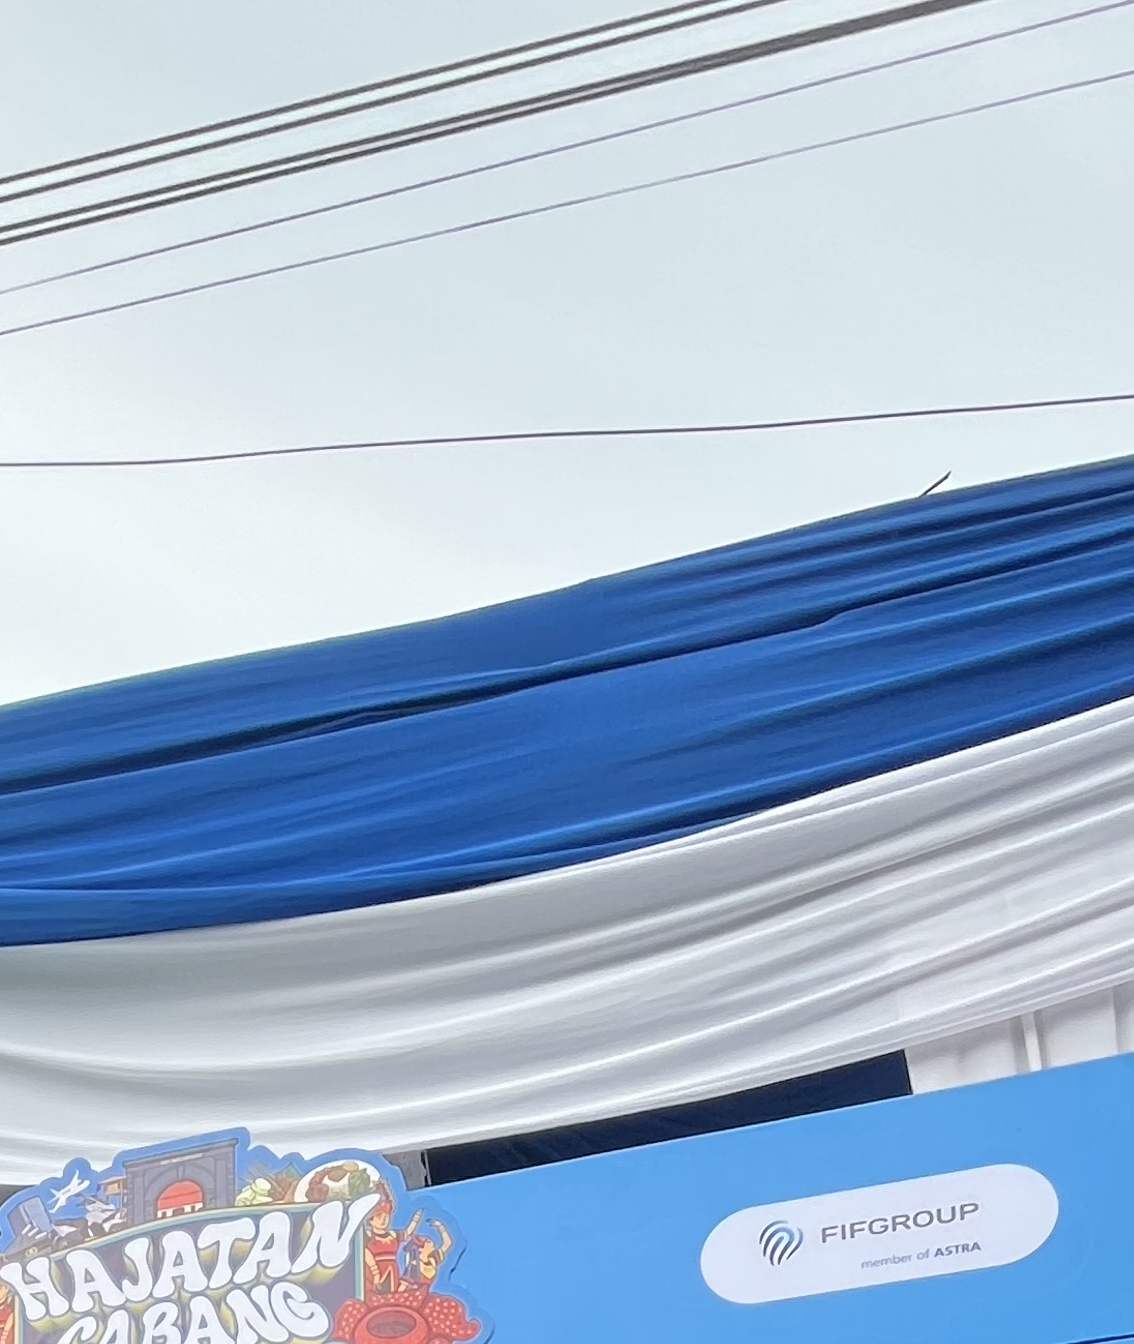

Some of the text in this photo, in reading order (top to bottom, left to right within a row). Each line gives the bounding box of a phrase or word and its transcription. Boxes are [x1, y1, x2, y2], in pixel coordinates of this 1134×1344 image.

[821, 1202, 979, 1244] FIFGROUP
[0, 1192, 381, 1321] HAJATAN
[861, 1241, 982, 1270] member of ASTRA
